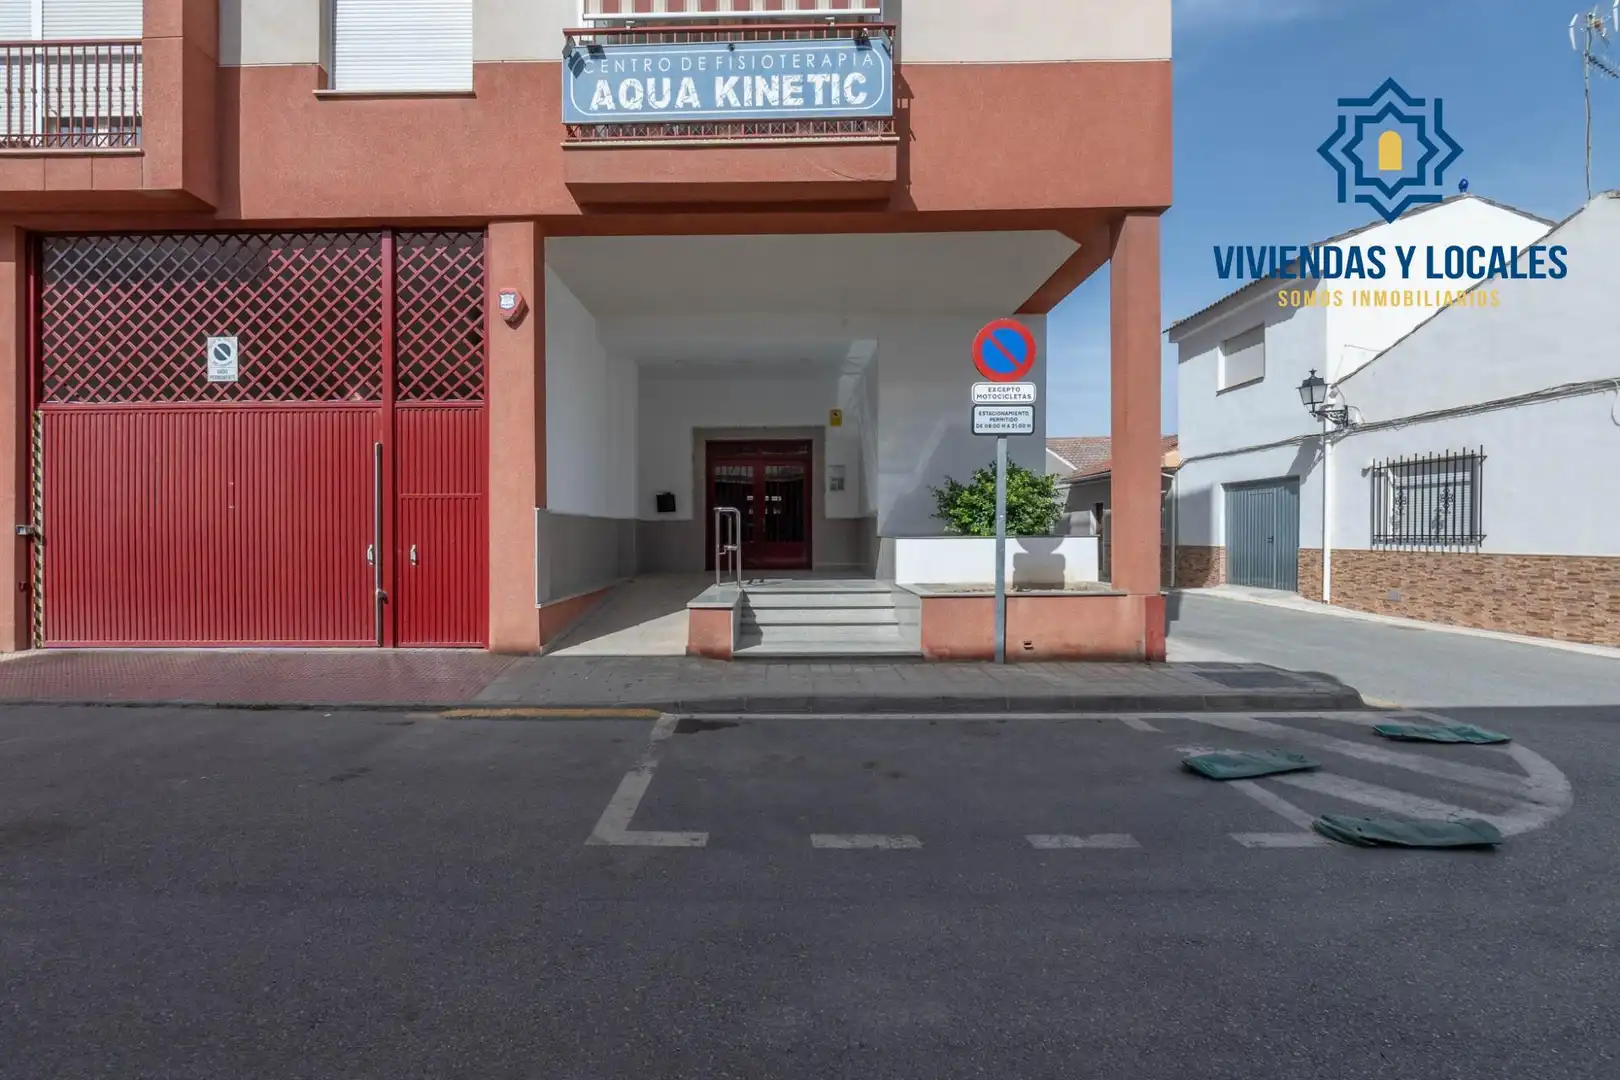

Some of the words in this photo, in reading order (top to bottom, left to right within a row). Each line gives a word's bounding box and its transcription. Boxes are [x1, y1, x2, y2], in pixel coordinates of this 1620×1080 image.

[583, 57, 671, 74] CENTRO
[681, 56, 707, 72] DE
[715, 52, 875, 71] FISIOTERAPIA
[589, 76, 701, 111] AQUA
[715, 72, 868, 108] KINETIC
